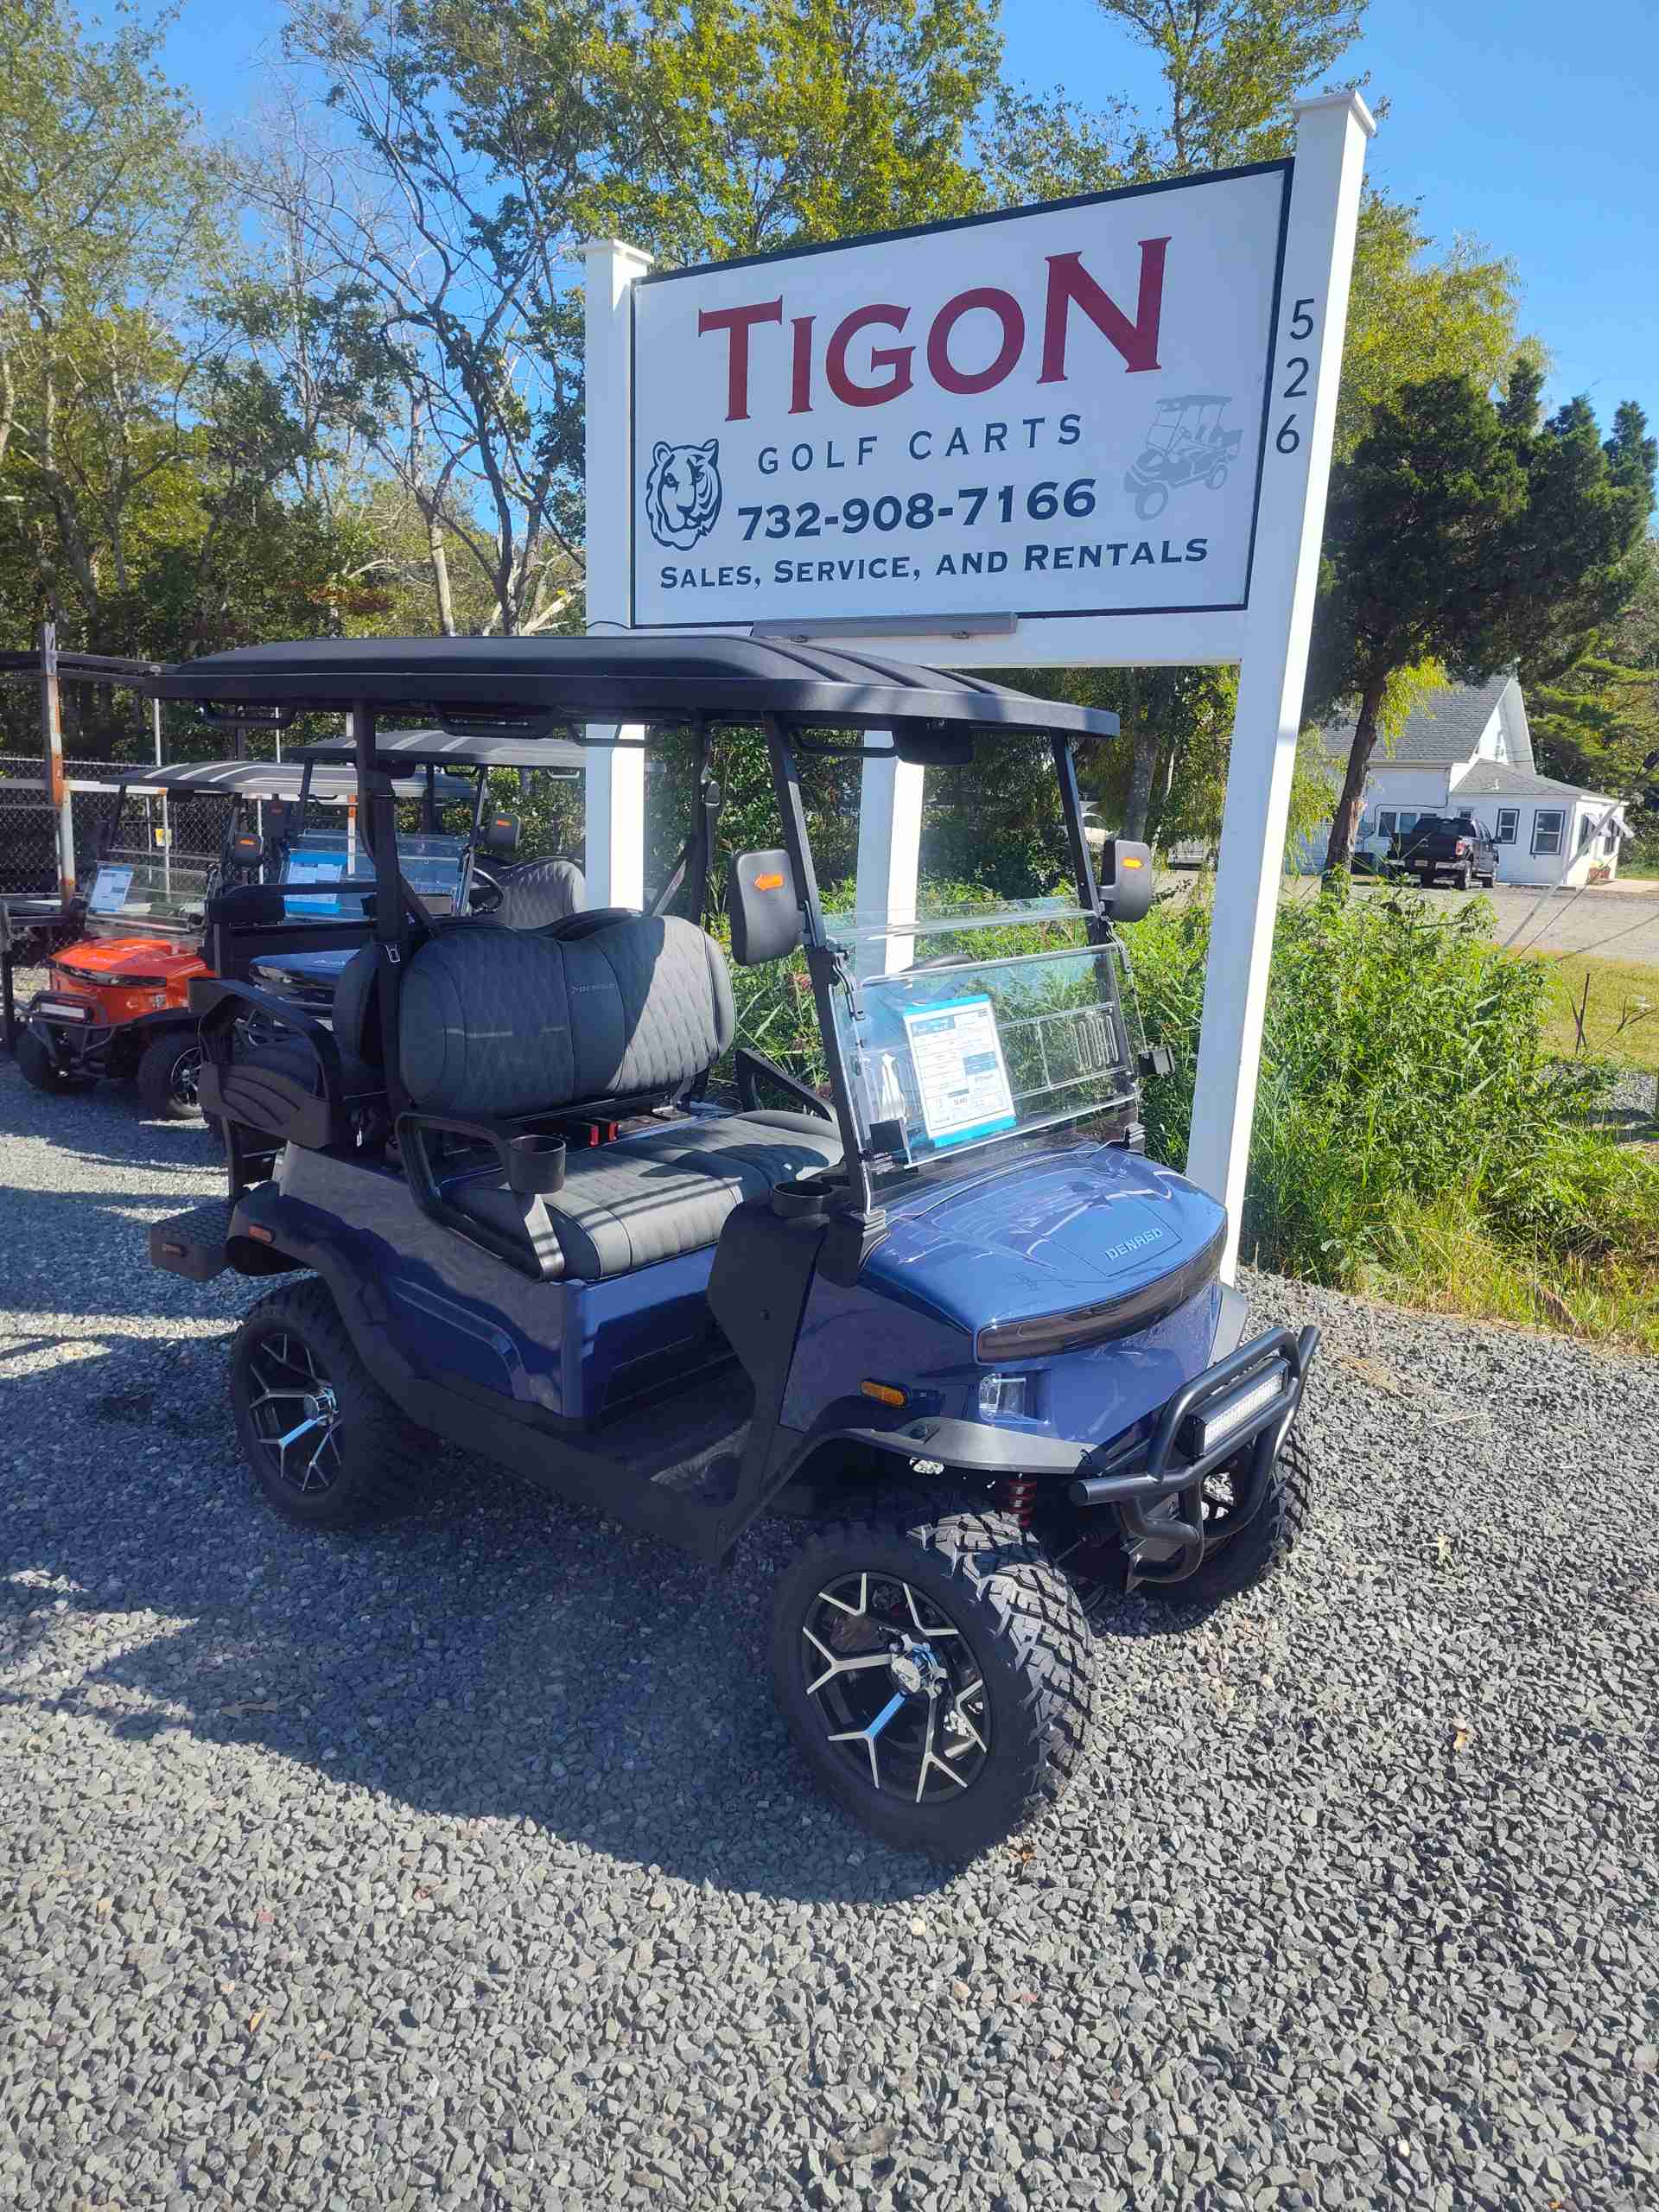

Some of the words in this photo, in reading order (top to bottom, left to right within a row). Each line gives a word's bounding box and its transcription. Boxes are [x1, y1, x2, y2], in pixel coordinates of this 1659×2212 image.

[697, 235, 1173, 423] TIGON
[758, 435, 878, 475] GOLF
[909, 413, 1083, 461] CARTS
[737, 477, 1097, 541] 732-908-7166
[659, 565, 761, 589] SALES,
[773, 556, 920, 584] SERVICE,
[935, 550, 1008, 576] AND
[1024, 537, 1209, 572] RENTALS
